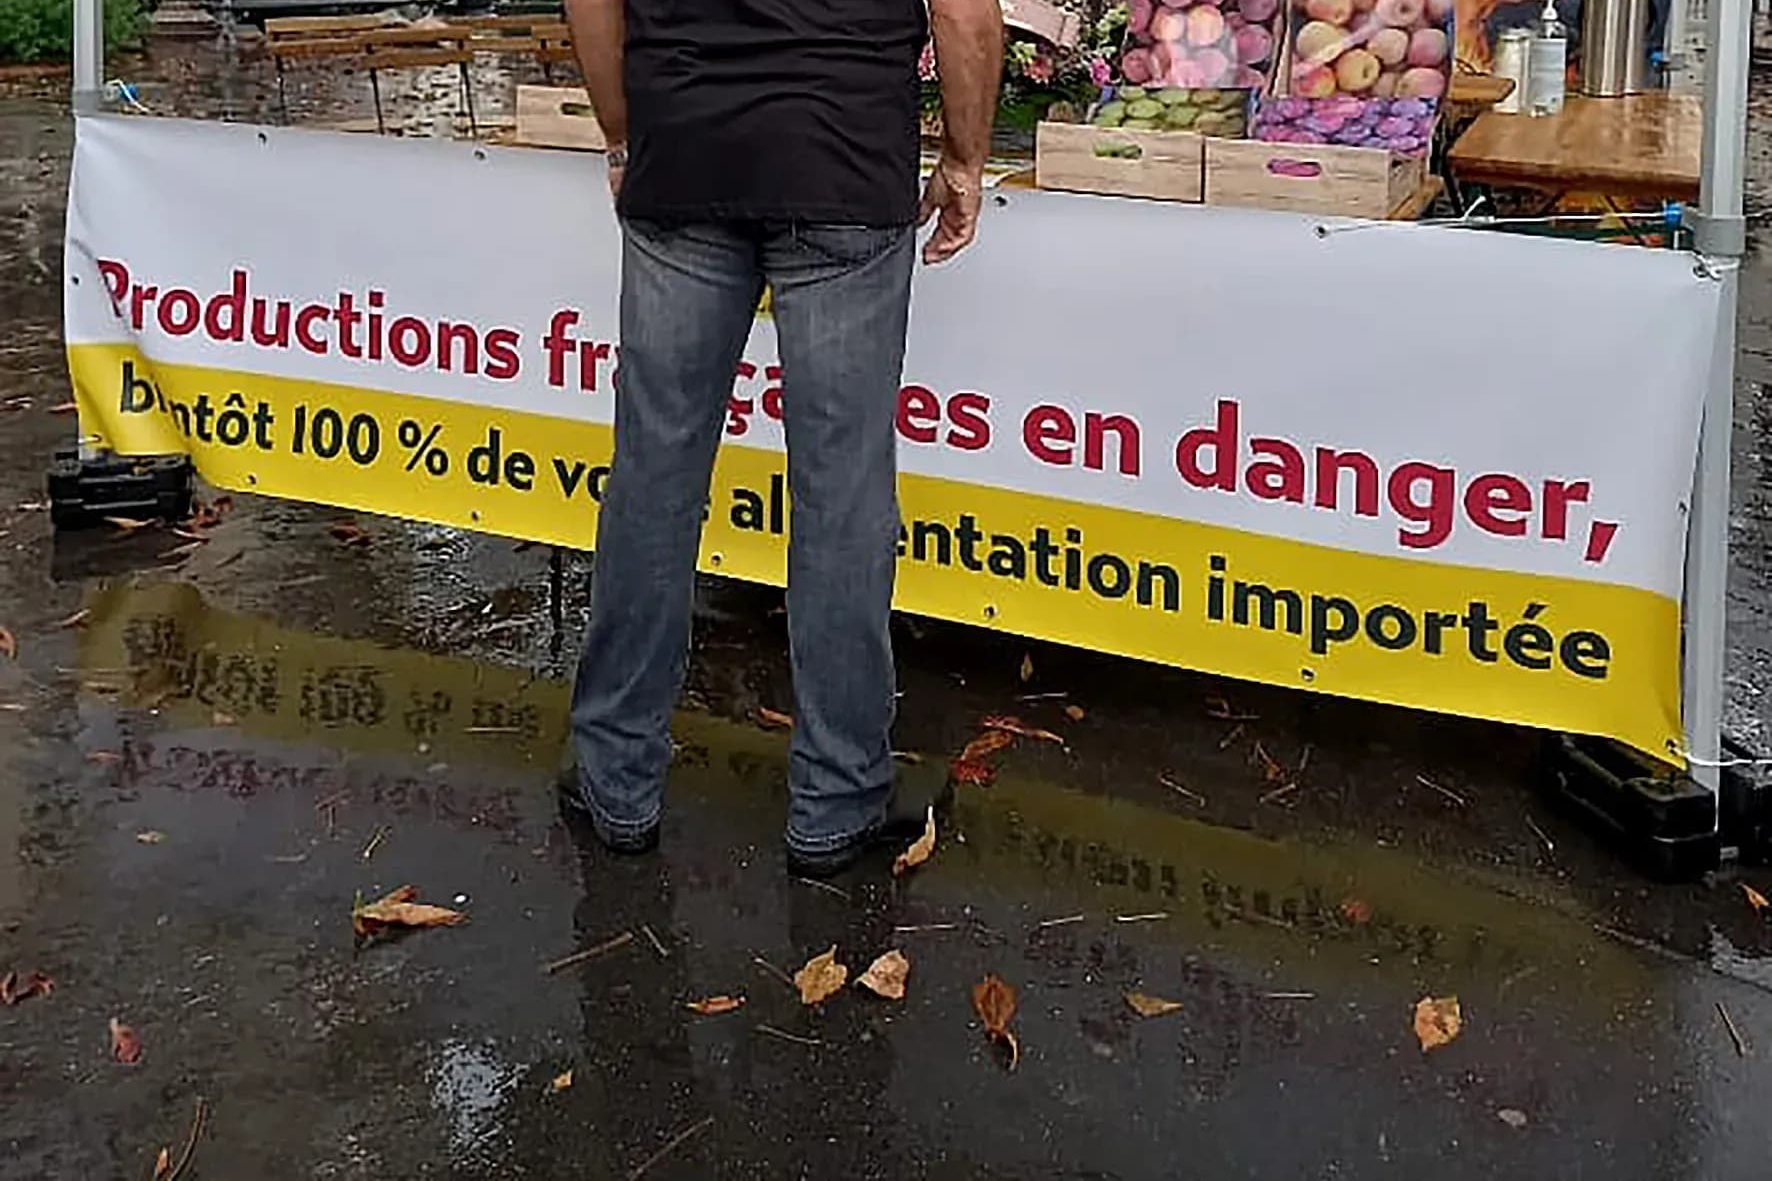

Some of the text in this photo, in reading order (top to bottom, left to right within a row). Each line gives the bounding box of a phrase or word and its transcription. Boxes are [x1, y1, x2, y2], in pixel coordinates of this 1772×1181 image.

[97, 259, 518, 380] Productions
[1022, 404, 1142, 477] en
[1176, 400, 1620, 564] danger,
[119, 360, 275, 451] bntôt
[291, 403, 381, 466] 100
[398, 420, 450, 478] %
[466, 427, 536, 493] de
[1206, 555, 1613, 680] importée
